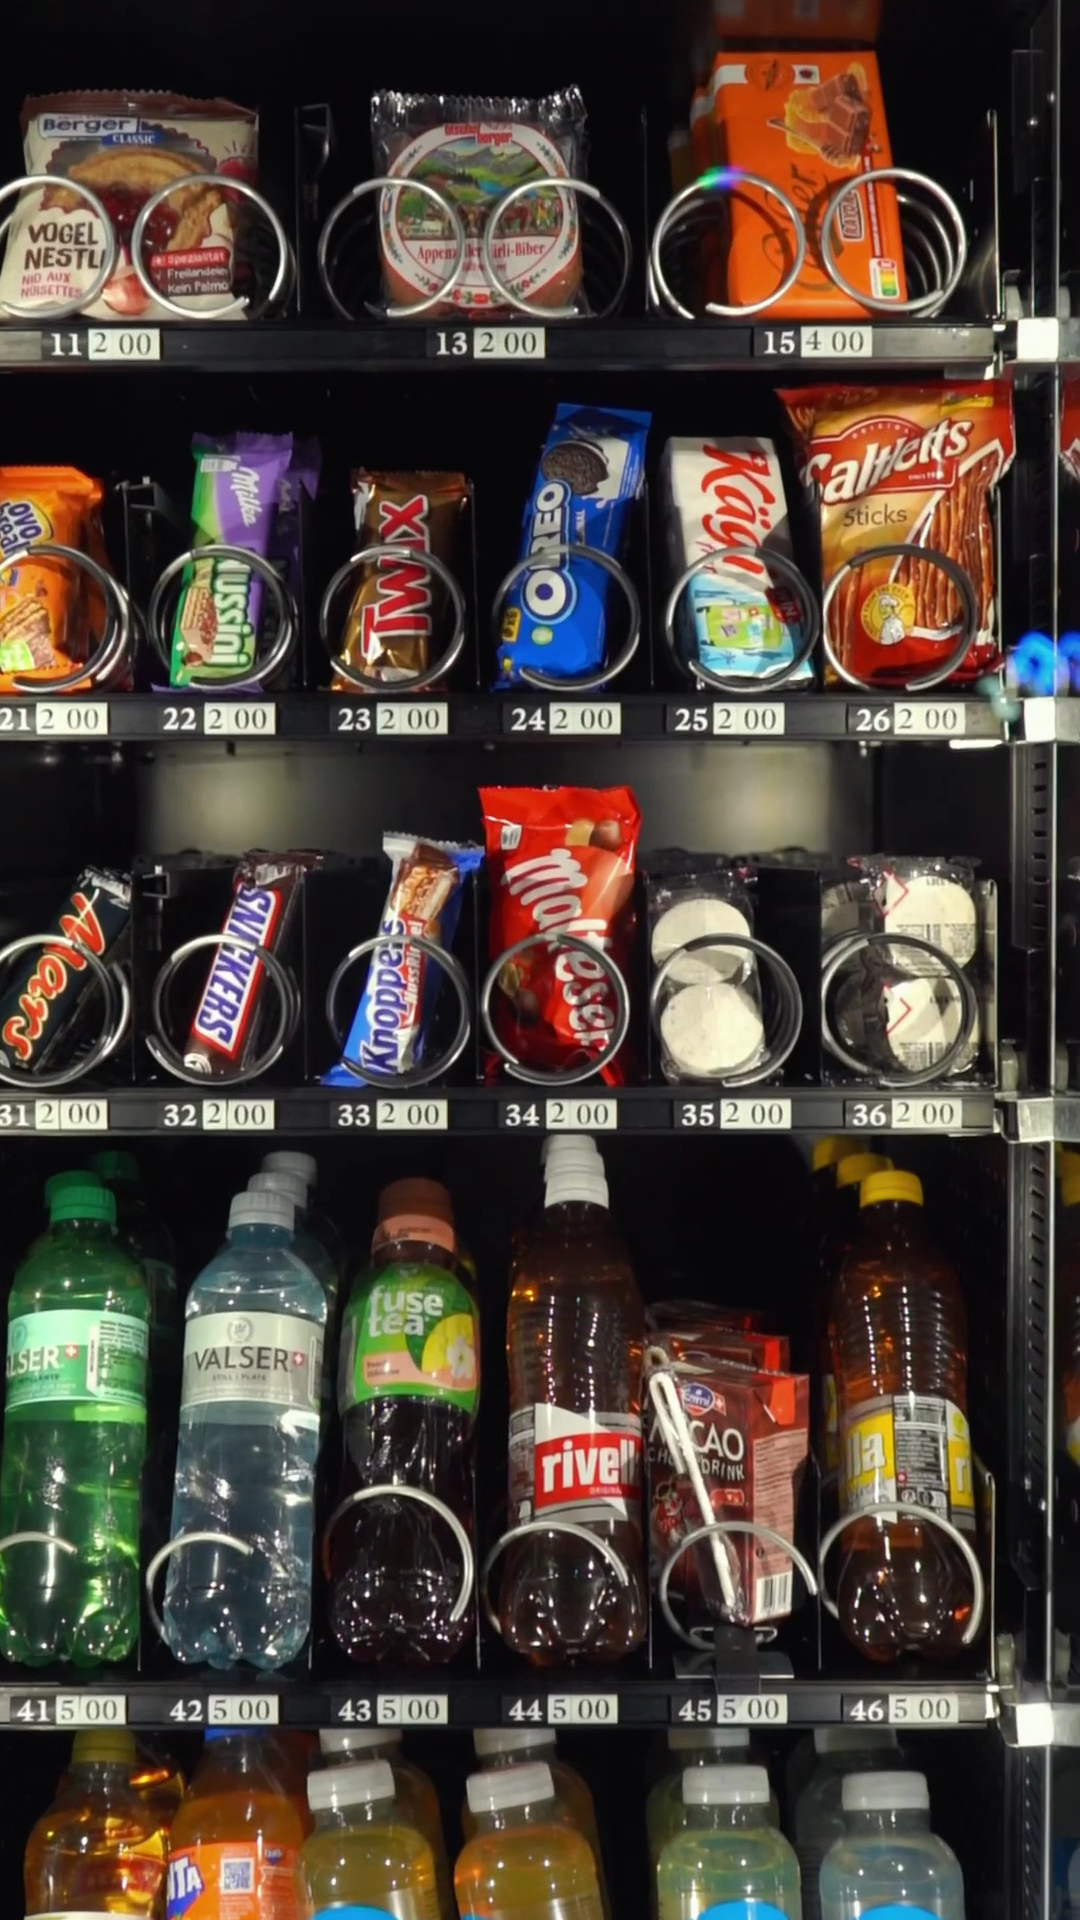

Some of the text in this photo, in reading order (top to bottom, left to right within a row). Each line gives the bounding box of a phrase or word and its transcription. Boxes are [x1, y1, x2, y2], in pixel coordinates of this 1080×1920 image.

[43, 118, 131, 134] Berger
[112, 134, 156, 145] CLASSIC
[28, 221, 99, 246] VOGEL
[418, 243, 483, 264] Appenzller
[22, 271, 71, 286] NID AUX
[21, 284, 84, 299] NOISETTES
[51, 333, 82, 356] 11
[437, 332, 468, 355] 13
[764, 330, 796, 354] 15
[230, 466, 263, 528] Milka
[843, 503, 907, 527] Sticks
[525, 481, 567, 616] OREO
[361, 495, 431, 659] TWIX
[0, 707, 32, 731] 21
[163, 707, 197, 731] 22
[338, 708, 371, 731] 23
[511, 707, 546, 731] 24
[674, 708, 708, 731] 25
[856, 708, 892, 732] 26
[0, 1103, 31, 1127] 31
[163, 1104, 197, 1127] 32
[338, 1104, 371, 1127] 33
[505, 1104, 540, 1126] 34
[681, 1103, 715, 1126] 35
[852, 1103, 887, 1127] 36
[370, 1285, 443, 1316] fuse
[367, 1311, 424, 1337] tea
[195, 1346, 288, 1371] VALSER
[648, 1412, 744, 1462] ACAO
[701, 1459, 745, 1481] DRINK
[17, 1699, 50, 1722] 41
[169, 1699, 203, 1722] 42
[338, 1699, 371, 1721] 43
[509, 1699, 543, 1721] 44
[678, 1700, 711, 1721] 45
[849, 1699, 884, 1722] 46
